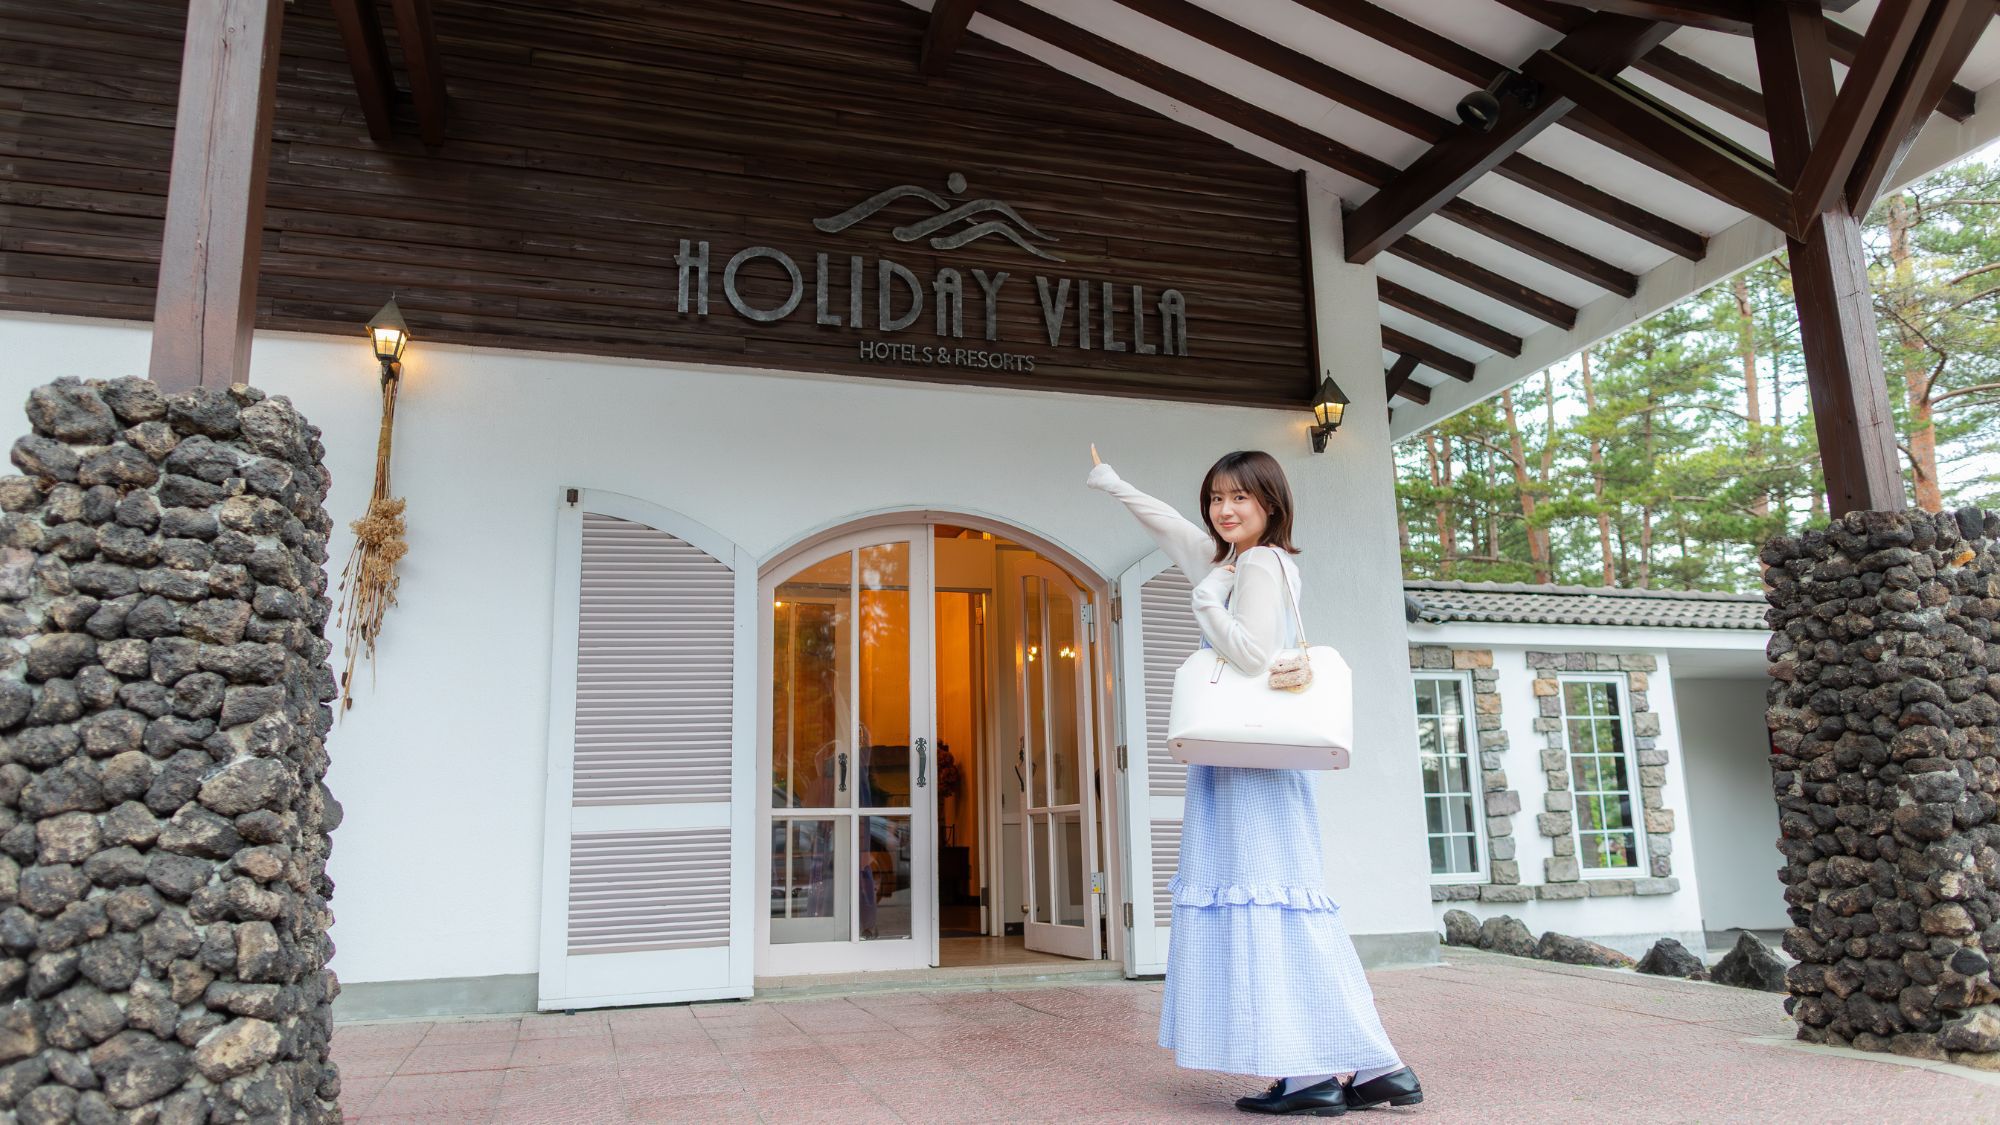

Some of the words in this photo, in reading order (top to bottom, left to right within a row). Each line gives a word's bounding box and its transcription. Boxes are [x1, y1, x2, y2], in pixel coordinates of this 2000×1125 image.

[674, 239, 1010, 341] HOLIDAY
[1036, 276, 1188, 356] VILLA
[860, 341, 932, 363] HOTELS
[955, 349, 1035, 372] RESORTS
